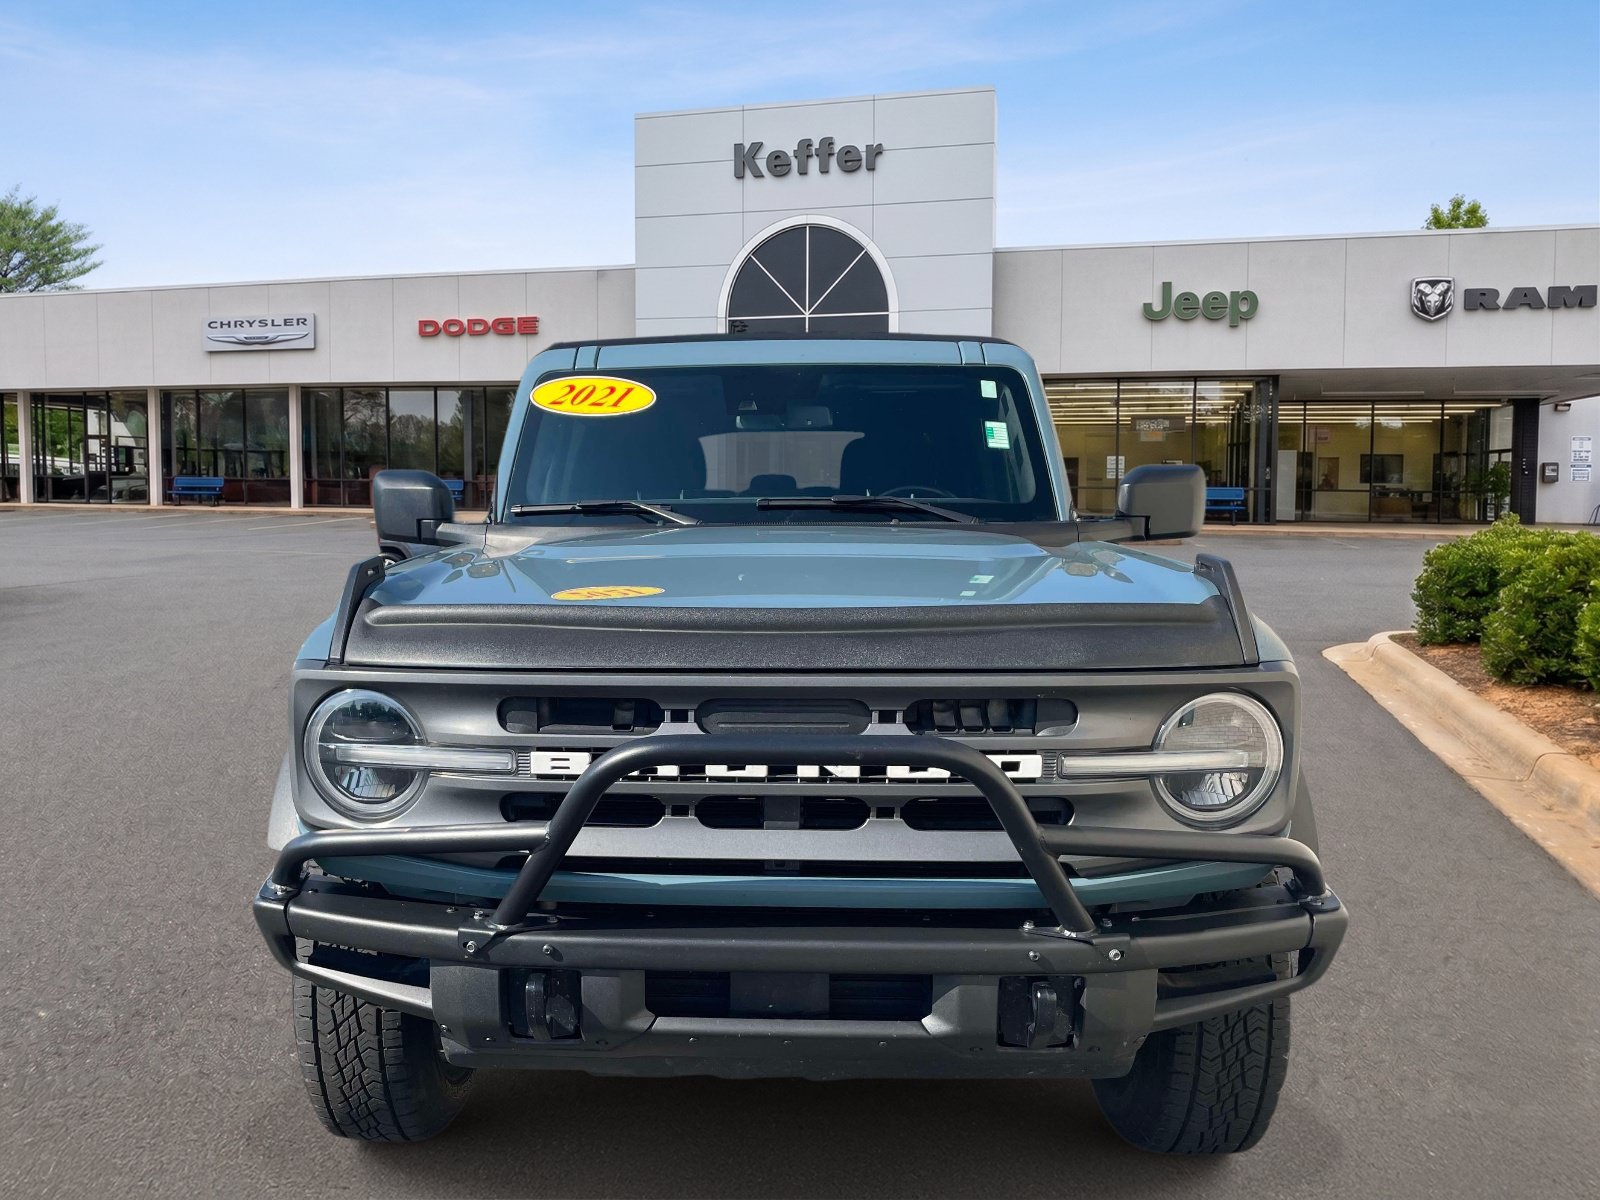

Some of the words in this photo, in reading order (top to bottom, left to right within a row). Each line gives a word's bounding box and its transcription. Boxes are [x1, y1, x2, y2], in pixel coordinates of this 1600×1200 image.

[734, 137, 883, 178] Keffer
[1143, 281, 1258, 328] Jeep
[1464, 285, 1598, 310] RAM
[208, 318, 308, 329] CHRYSLER
[418, 317, 539, 337] DODGE
[548, 384, 635, 408] 2021
